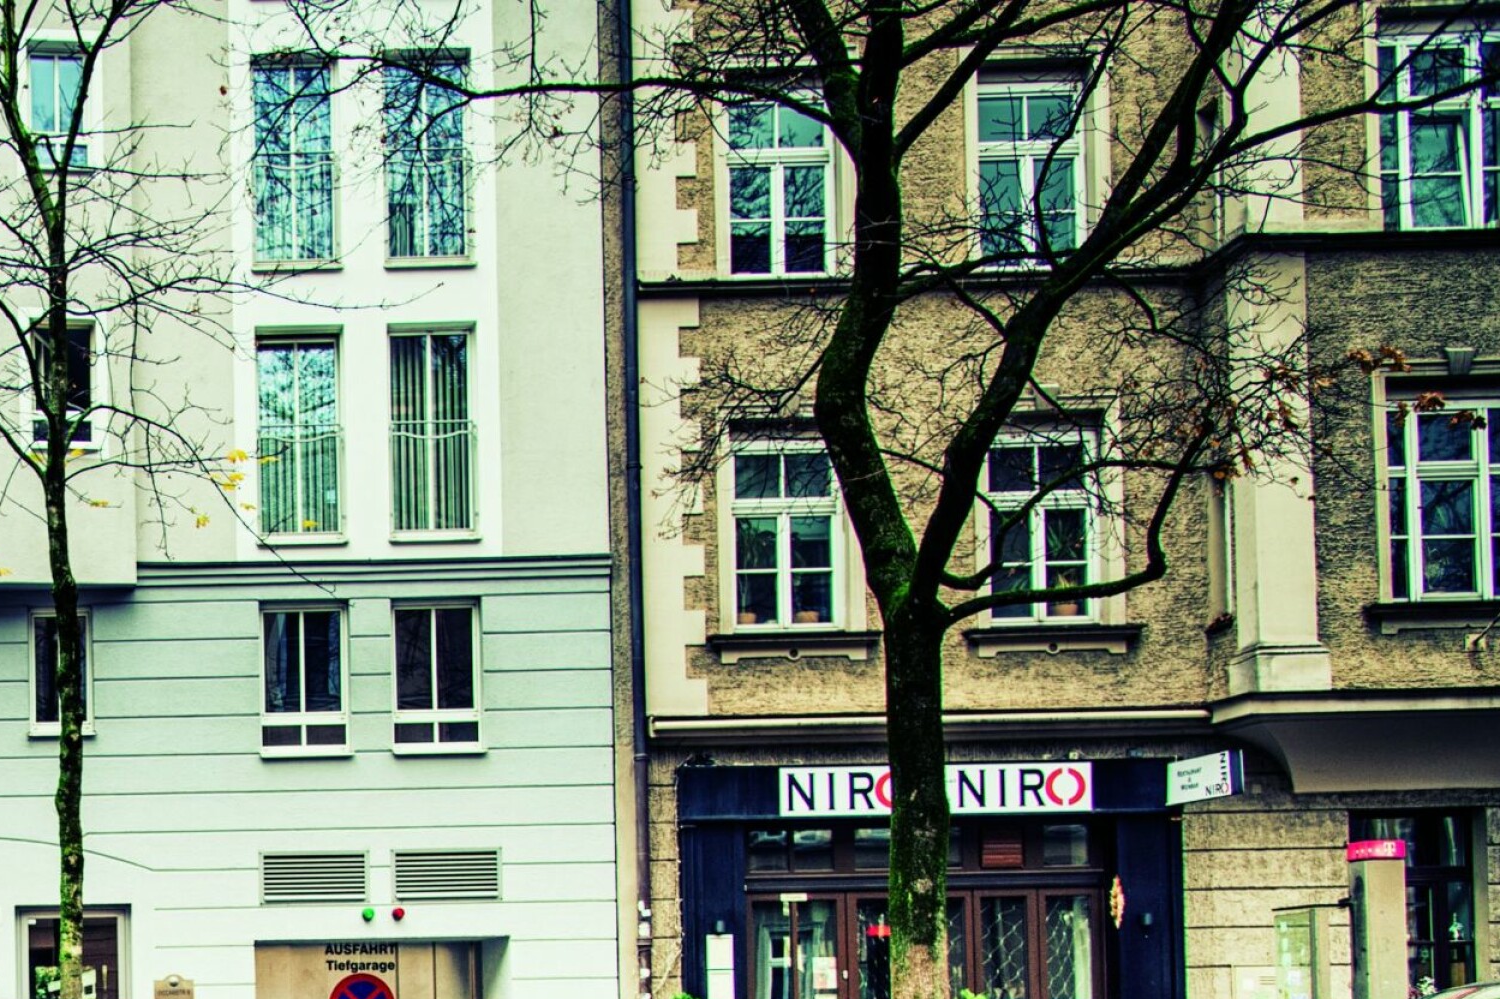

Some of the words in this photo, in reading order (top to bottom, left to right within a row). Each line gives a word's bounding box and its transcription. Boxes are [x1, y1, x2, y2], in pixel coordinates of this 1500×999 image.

[959, 767, 1086, 808] NIRO
[325, 942, 396, 955] AUSFAHRT
[326, 960, 396, 974] Tiefgarage
